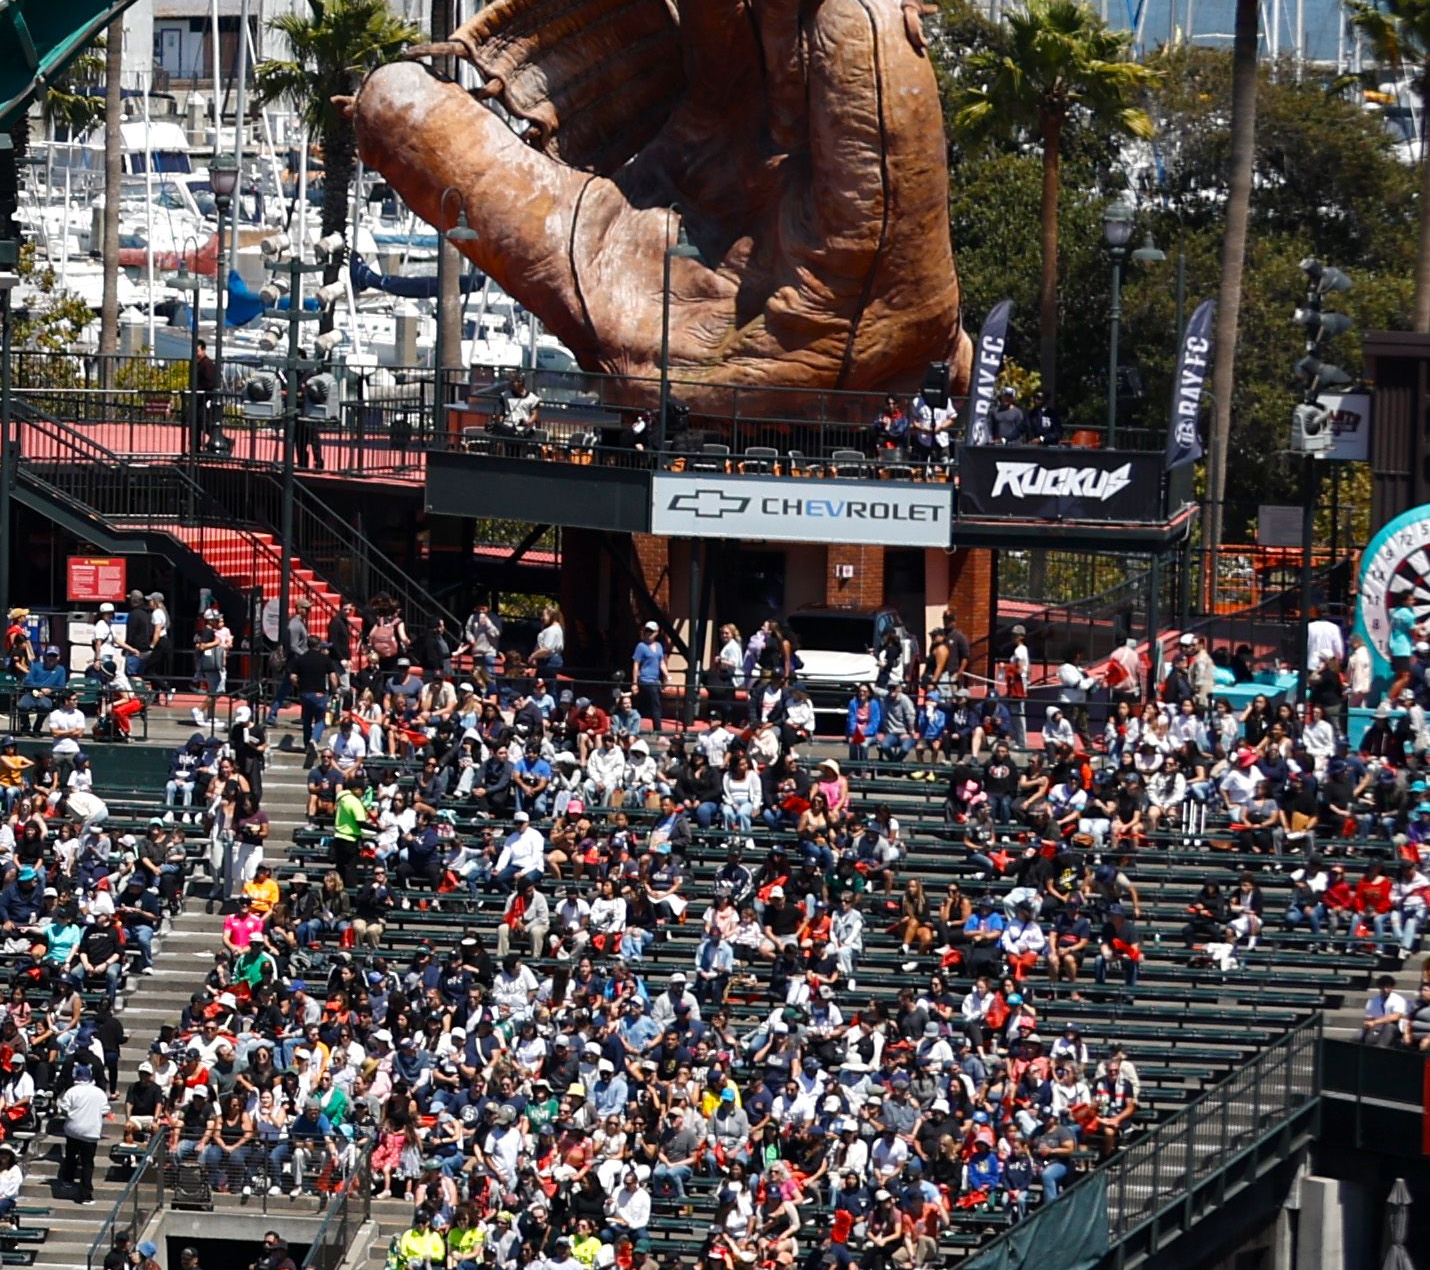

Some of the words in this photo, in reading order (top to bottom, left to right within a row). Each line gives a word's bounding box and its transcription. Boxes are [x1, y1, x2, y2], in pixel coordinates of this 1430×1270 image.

[1184, 335, 1209, 367] FC
[991, 462, 1133, 502] RUCKUS
[761, 496, 944, 523] CHEVROLET
